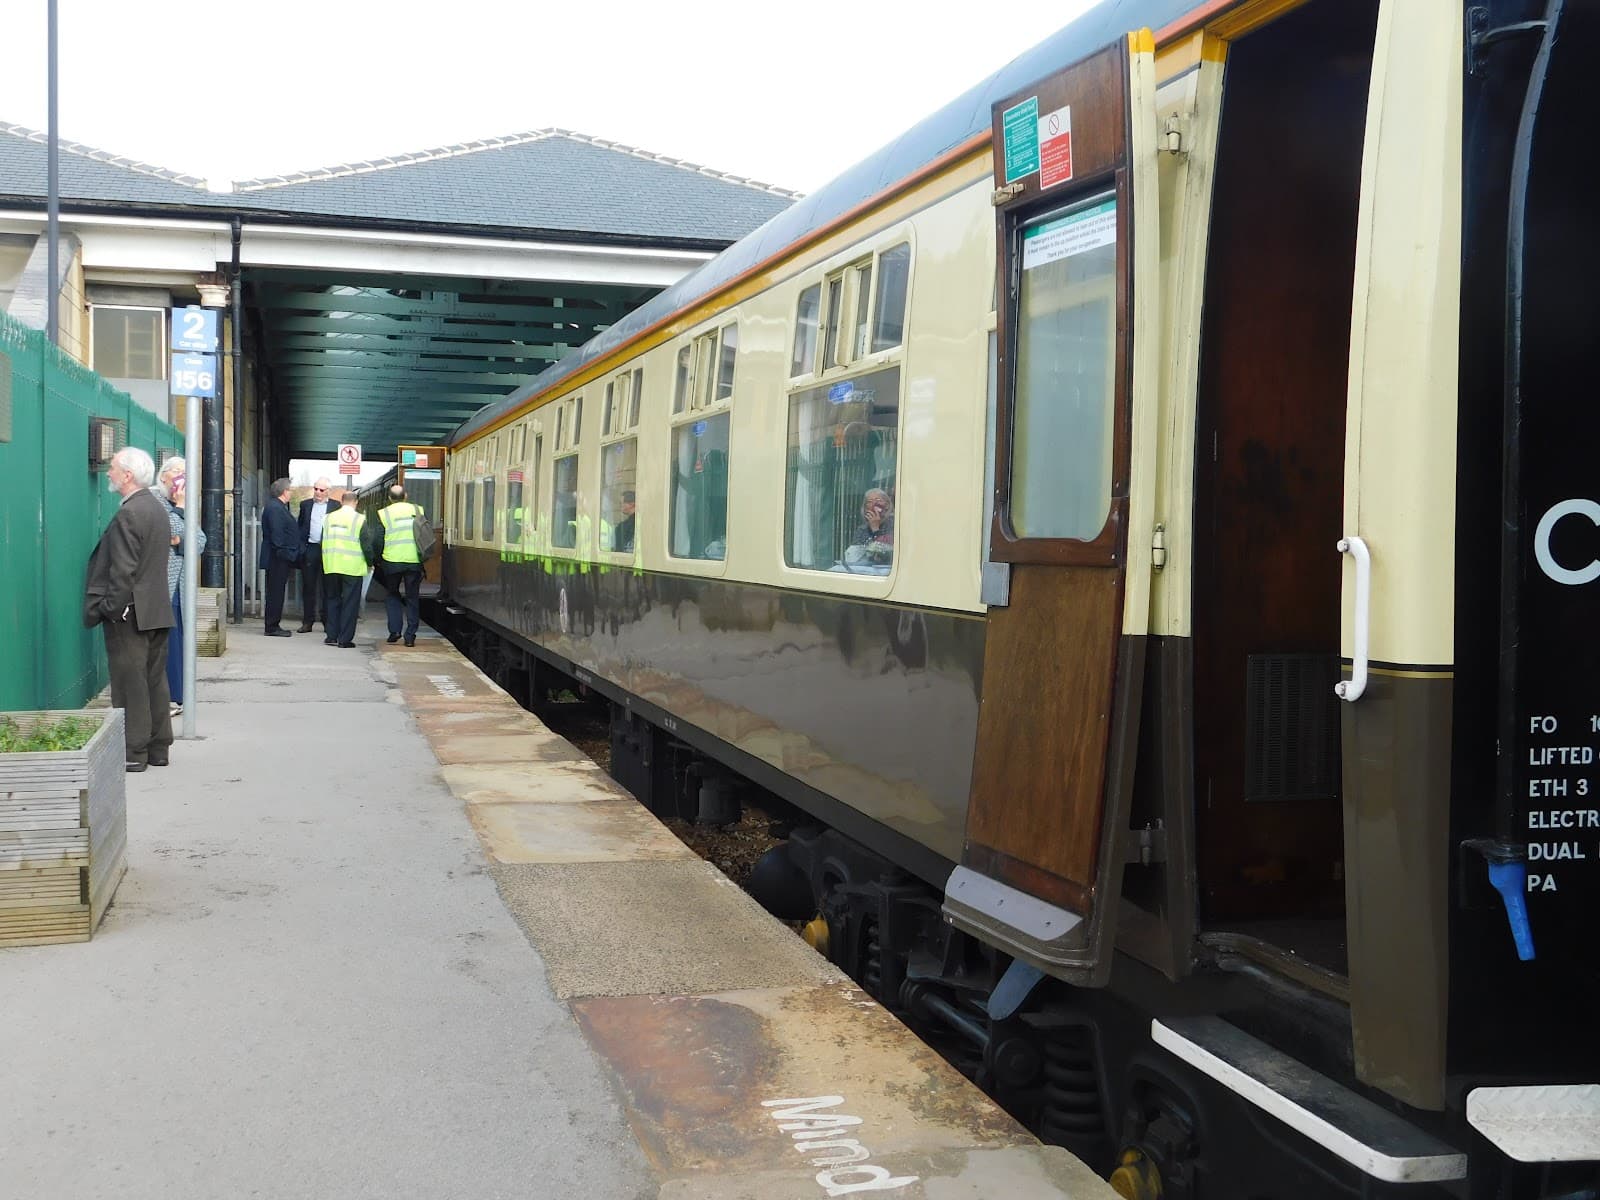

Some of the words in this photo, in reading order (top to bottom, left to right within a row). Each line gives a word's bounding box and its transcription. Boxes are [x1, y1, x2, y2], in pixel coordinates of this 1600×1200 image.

[183, 312, 205, 340] 2
[175, 370, 213, 391] 156
[1531, 716, 1557, 733] FO
[1530, 747, 1592, 765] LIFTED
[1530, 779, 1567, 797] ETH
[1576, 779, 1588, 796] 3
[1529, 810, 1600, 828] ELECTR
[1528, 842, 1585, 860] DUAL
[1528, 874, 1557, 892] PA
[761, 1096, 920, 1197] Mind
